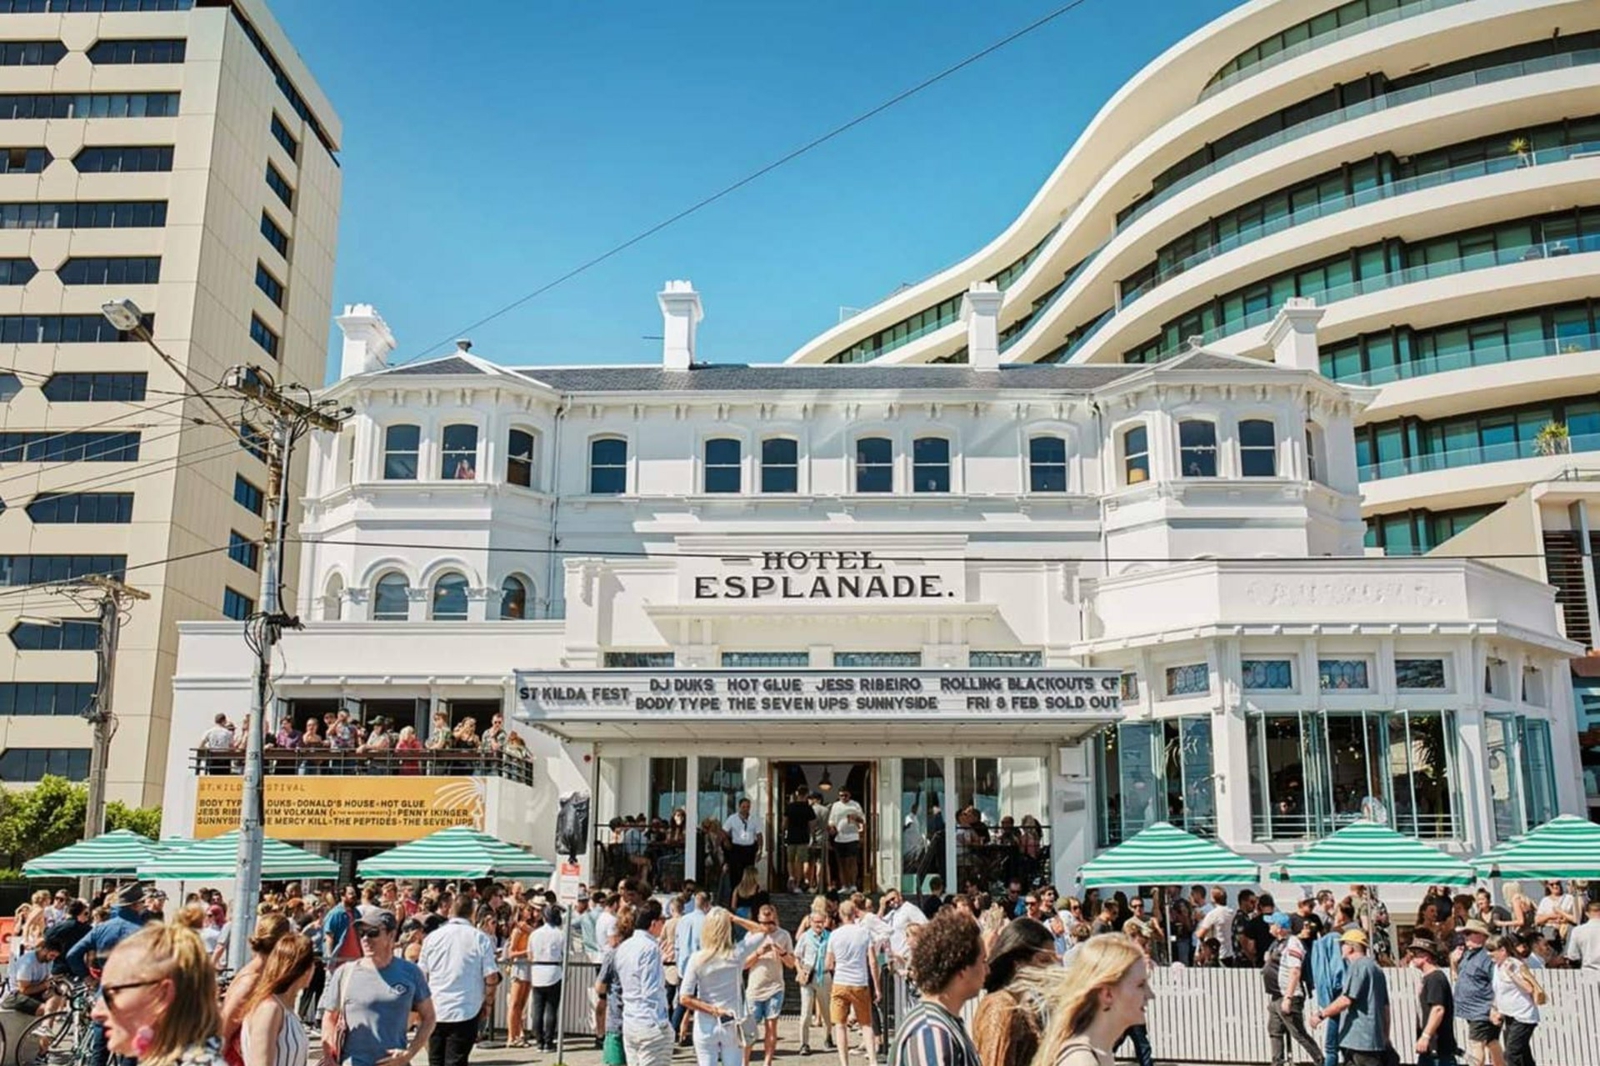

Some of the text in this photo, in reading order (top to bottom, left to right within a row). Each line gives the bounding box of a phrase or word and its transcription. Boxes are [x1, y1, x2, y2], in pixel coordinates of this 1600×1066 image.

[761, 551, 883, 571] HOTEL
[694, 575, 954, 599] ESPLANADE.
[650, 677, 1119, 691] DJ DUKS HOT GLUE JESS RIBEIRO ROLLING BLACKOUTS CF
[520, 687, 630, 700] ST KILDA FEST
[636, 696, 938, 710] BODY TYPE THE SEVEN UPS SUNNYSIDE
[966, 696, 1119, 709] FRI 8 FEB SOLD OUT
[200, 799, 224, 807] BODY
[226, 799, 242, 807] TYP
[197, 808, 220, 816] JESS
[265, 808, 281, 816] KIM
[284, 808, 327, 816] VOLKMAN
[397, 808, 428, 816] PENNY
[431, 808, 468, 816] IKINGER
[275, 817, 305, 825] MERCY
[308, 817, 328, 825] KILL
[334, 817, 351, 825] THE
[353, 817, 397, 825] PEPTIDES
[403, 817, 421, 825] THE
[423, 817, 453, 825] SEVEN
[455, 817, 474, 825] UPS
